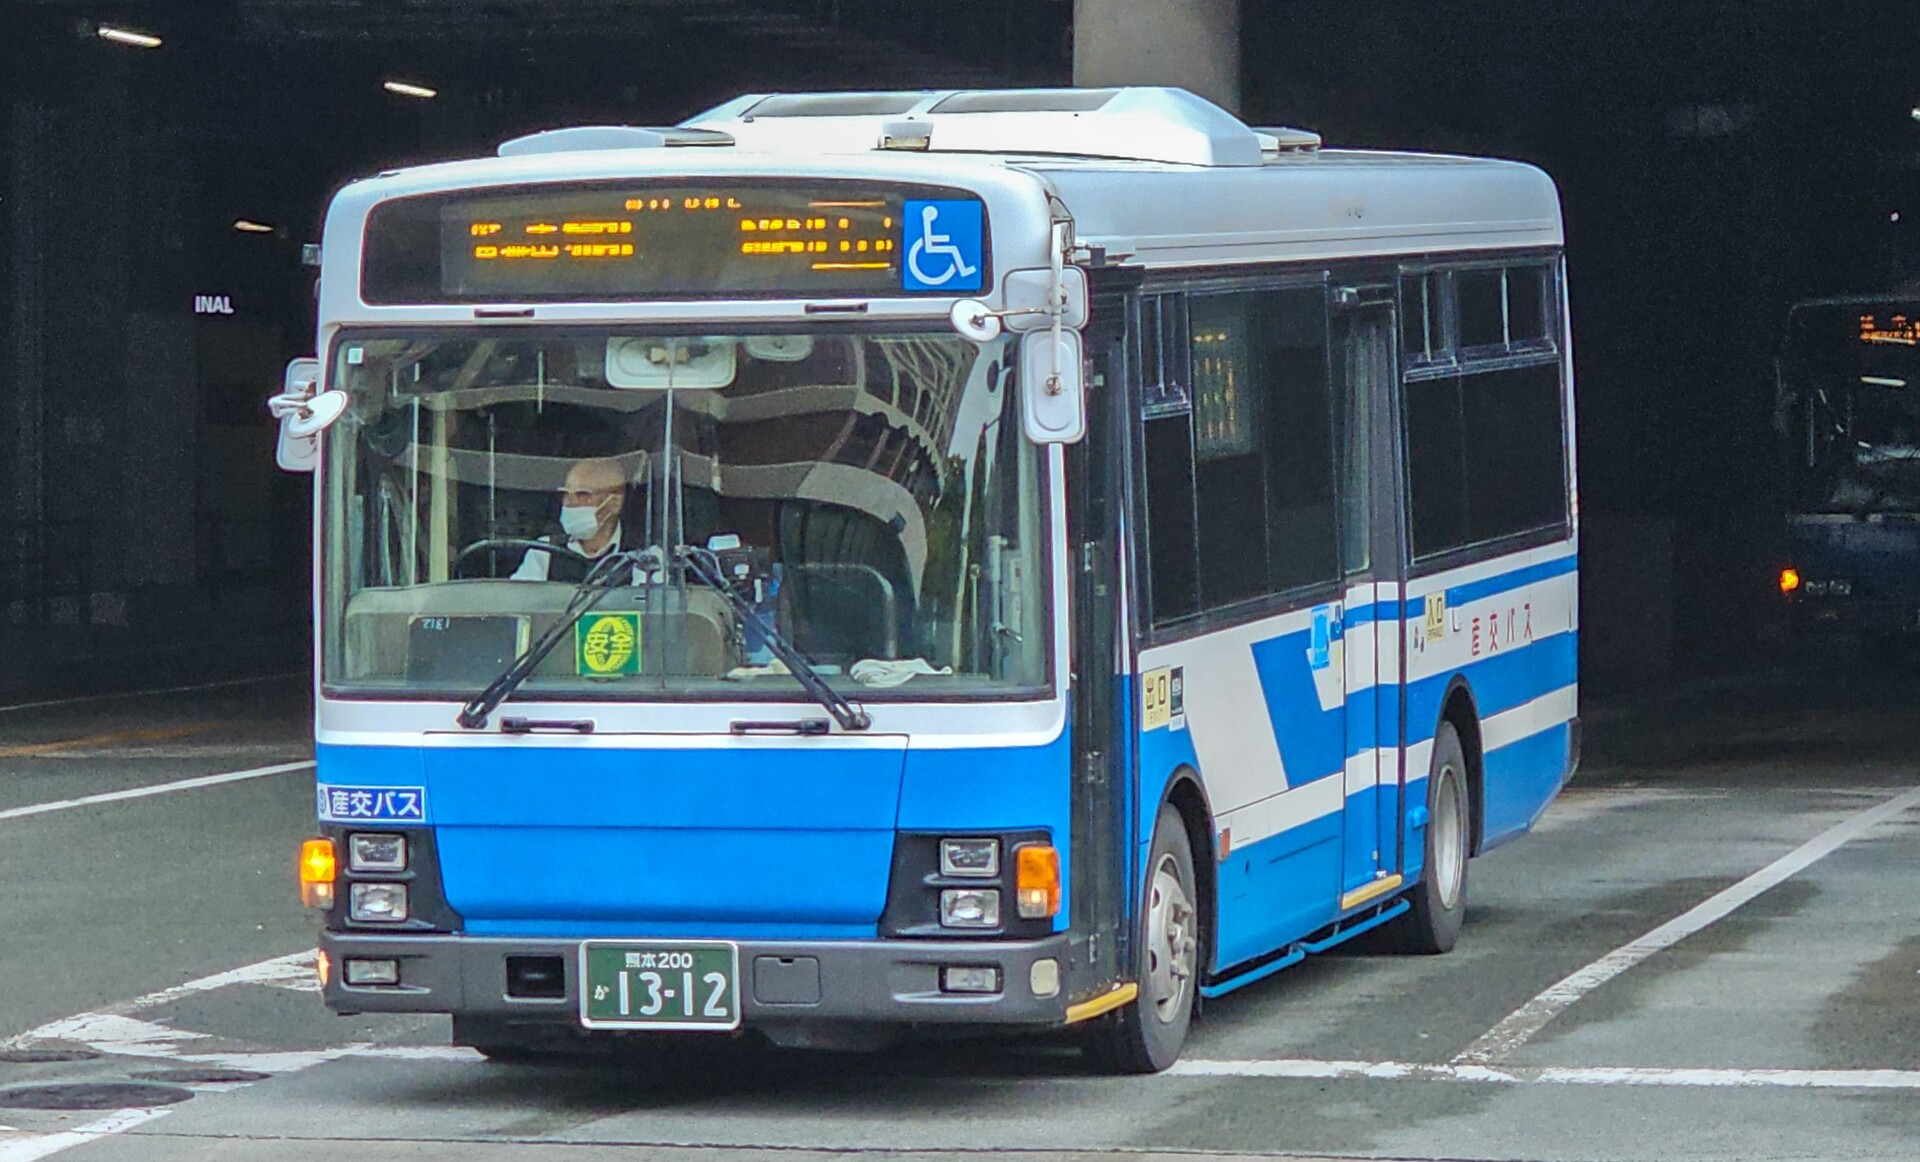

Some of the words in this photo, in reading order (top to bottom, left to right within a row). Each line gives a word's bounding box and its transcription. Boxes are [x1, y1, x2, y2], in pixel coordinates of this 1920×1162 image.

[195, 295, 234, 314] INAL
[331, 790, 420, 816] 産交バス
[594, 984, 610, 1000] か
[619, 971, 727, 1016] 13-12
